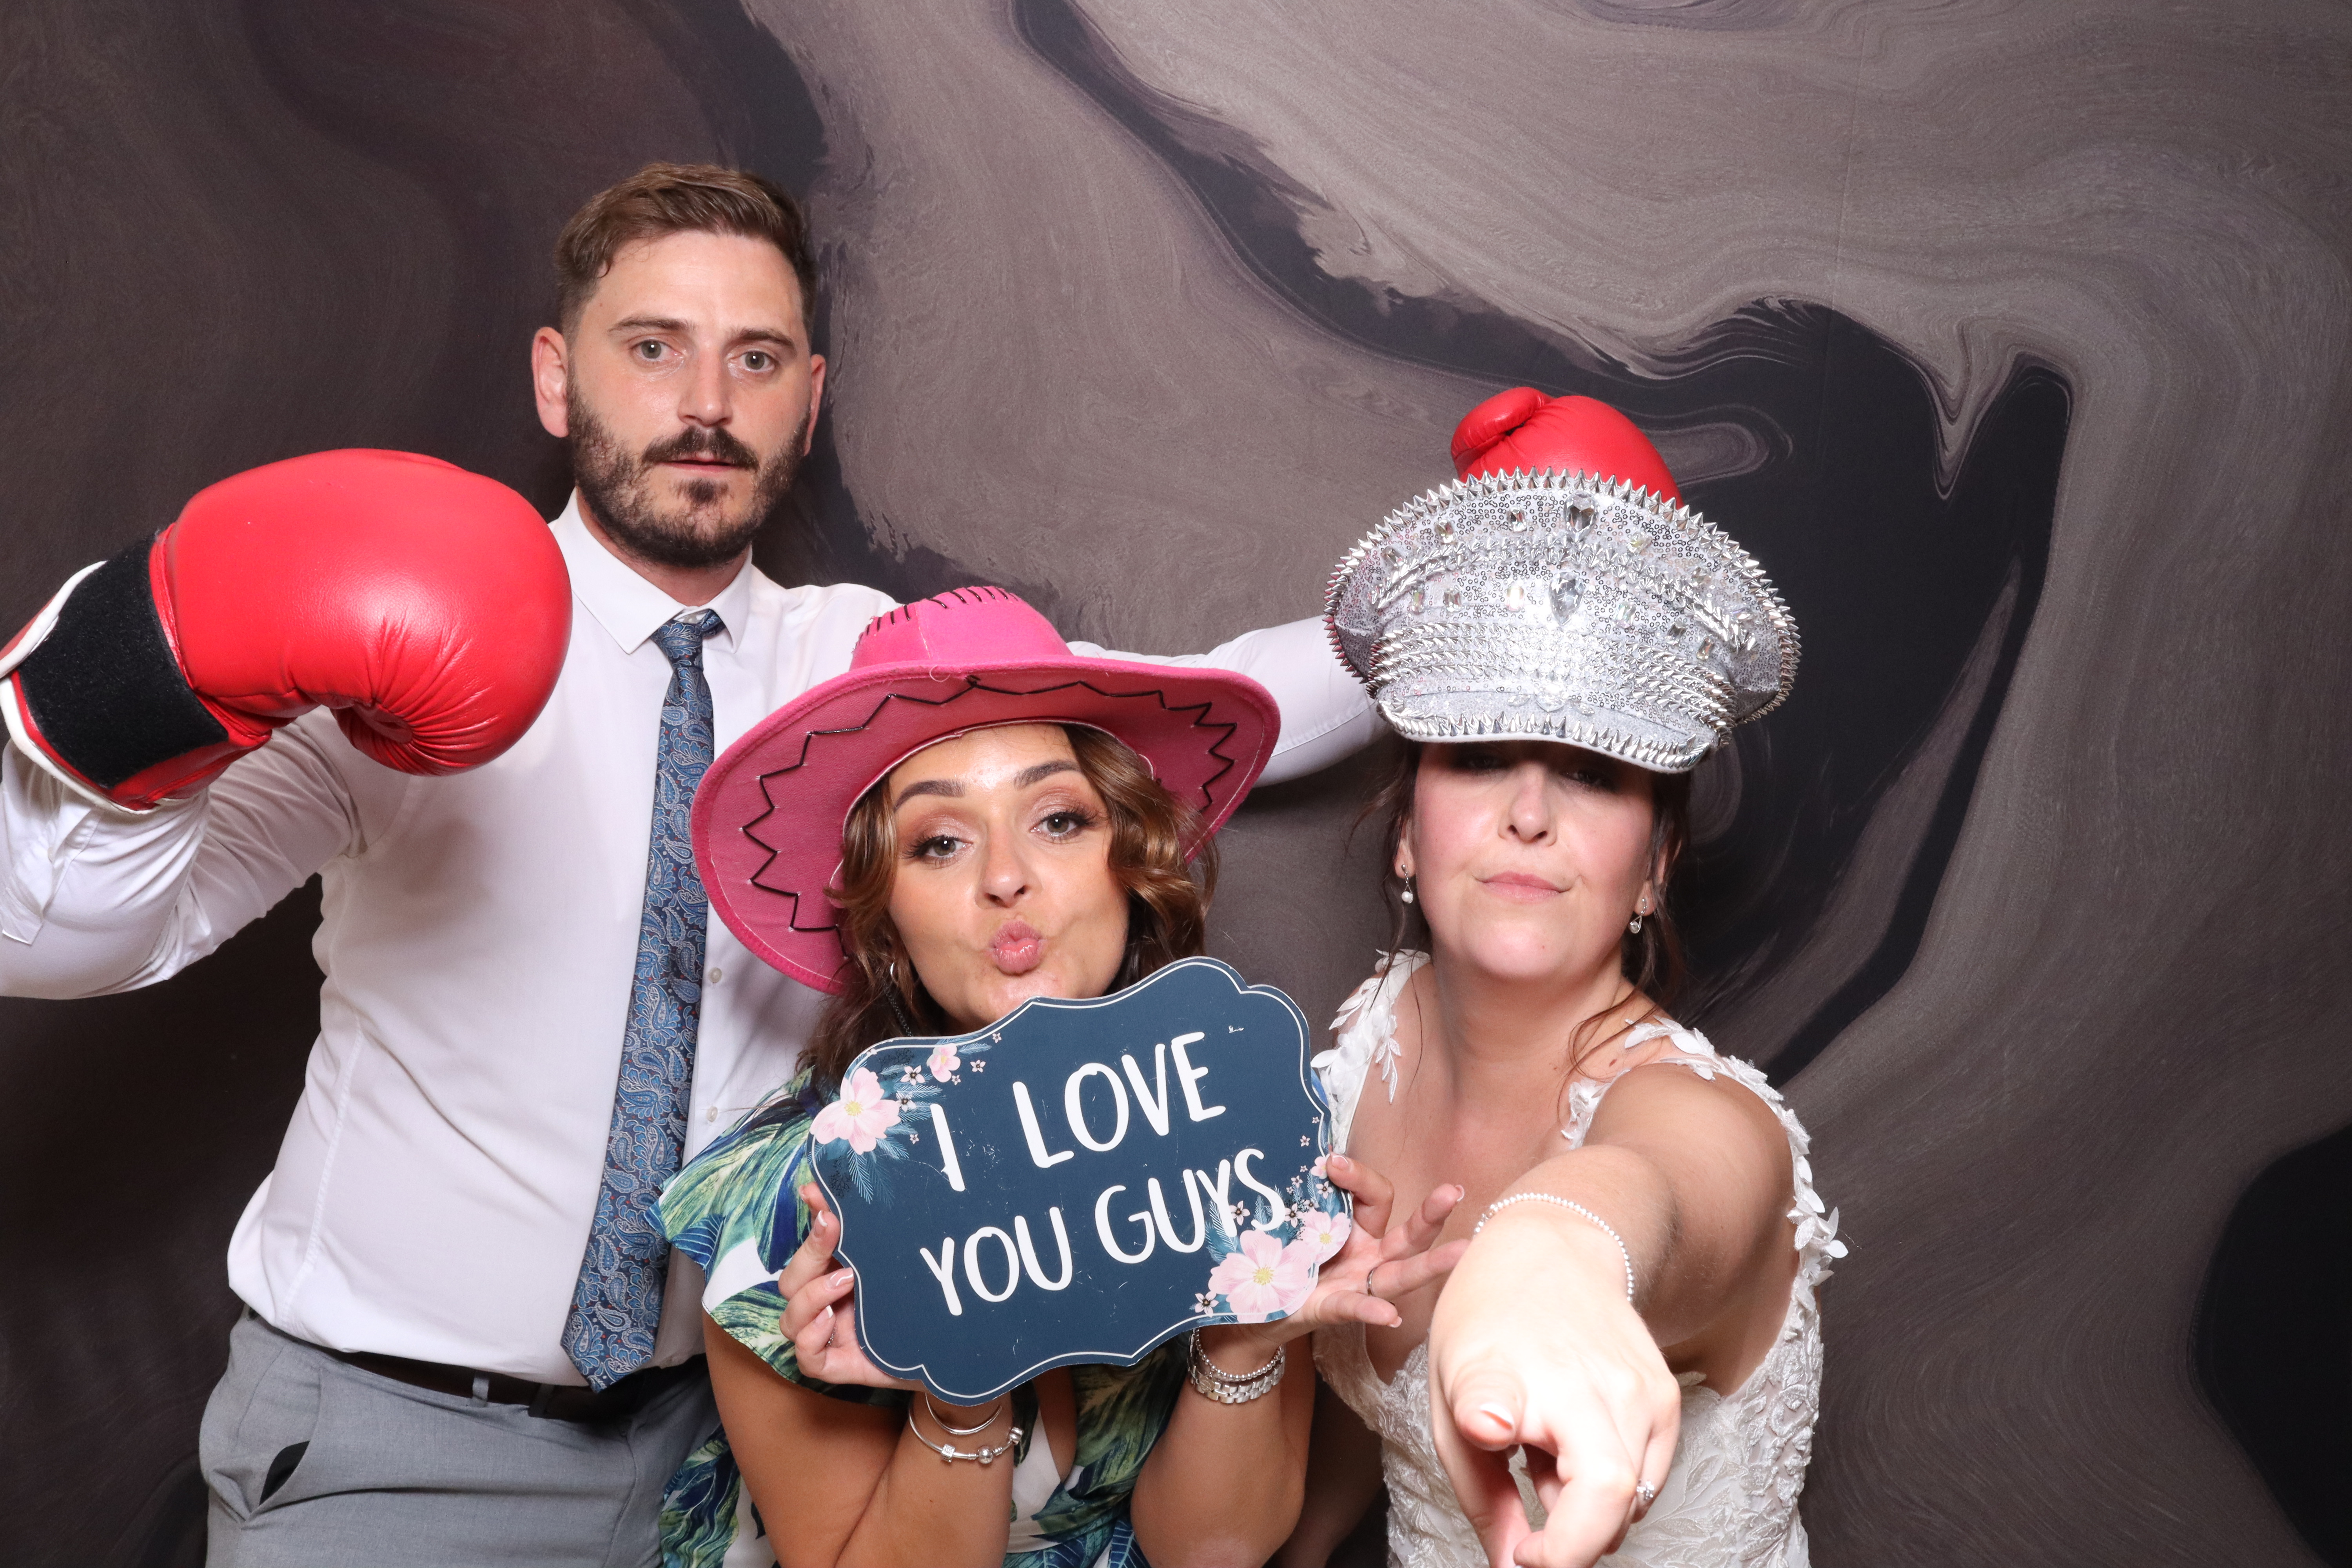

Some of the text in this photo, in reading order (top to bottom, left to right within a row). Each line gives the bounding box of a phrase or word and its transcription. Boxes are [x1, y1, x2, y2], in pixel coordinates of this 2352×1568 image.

[930, 1032, 1226, 1192] I LOVE
[920, 1148, 1286, 1316] YOU GUYS
